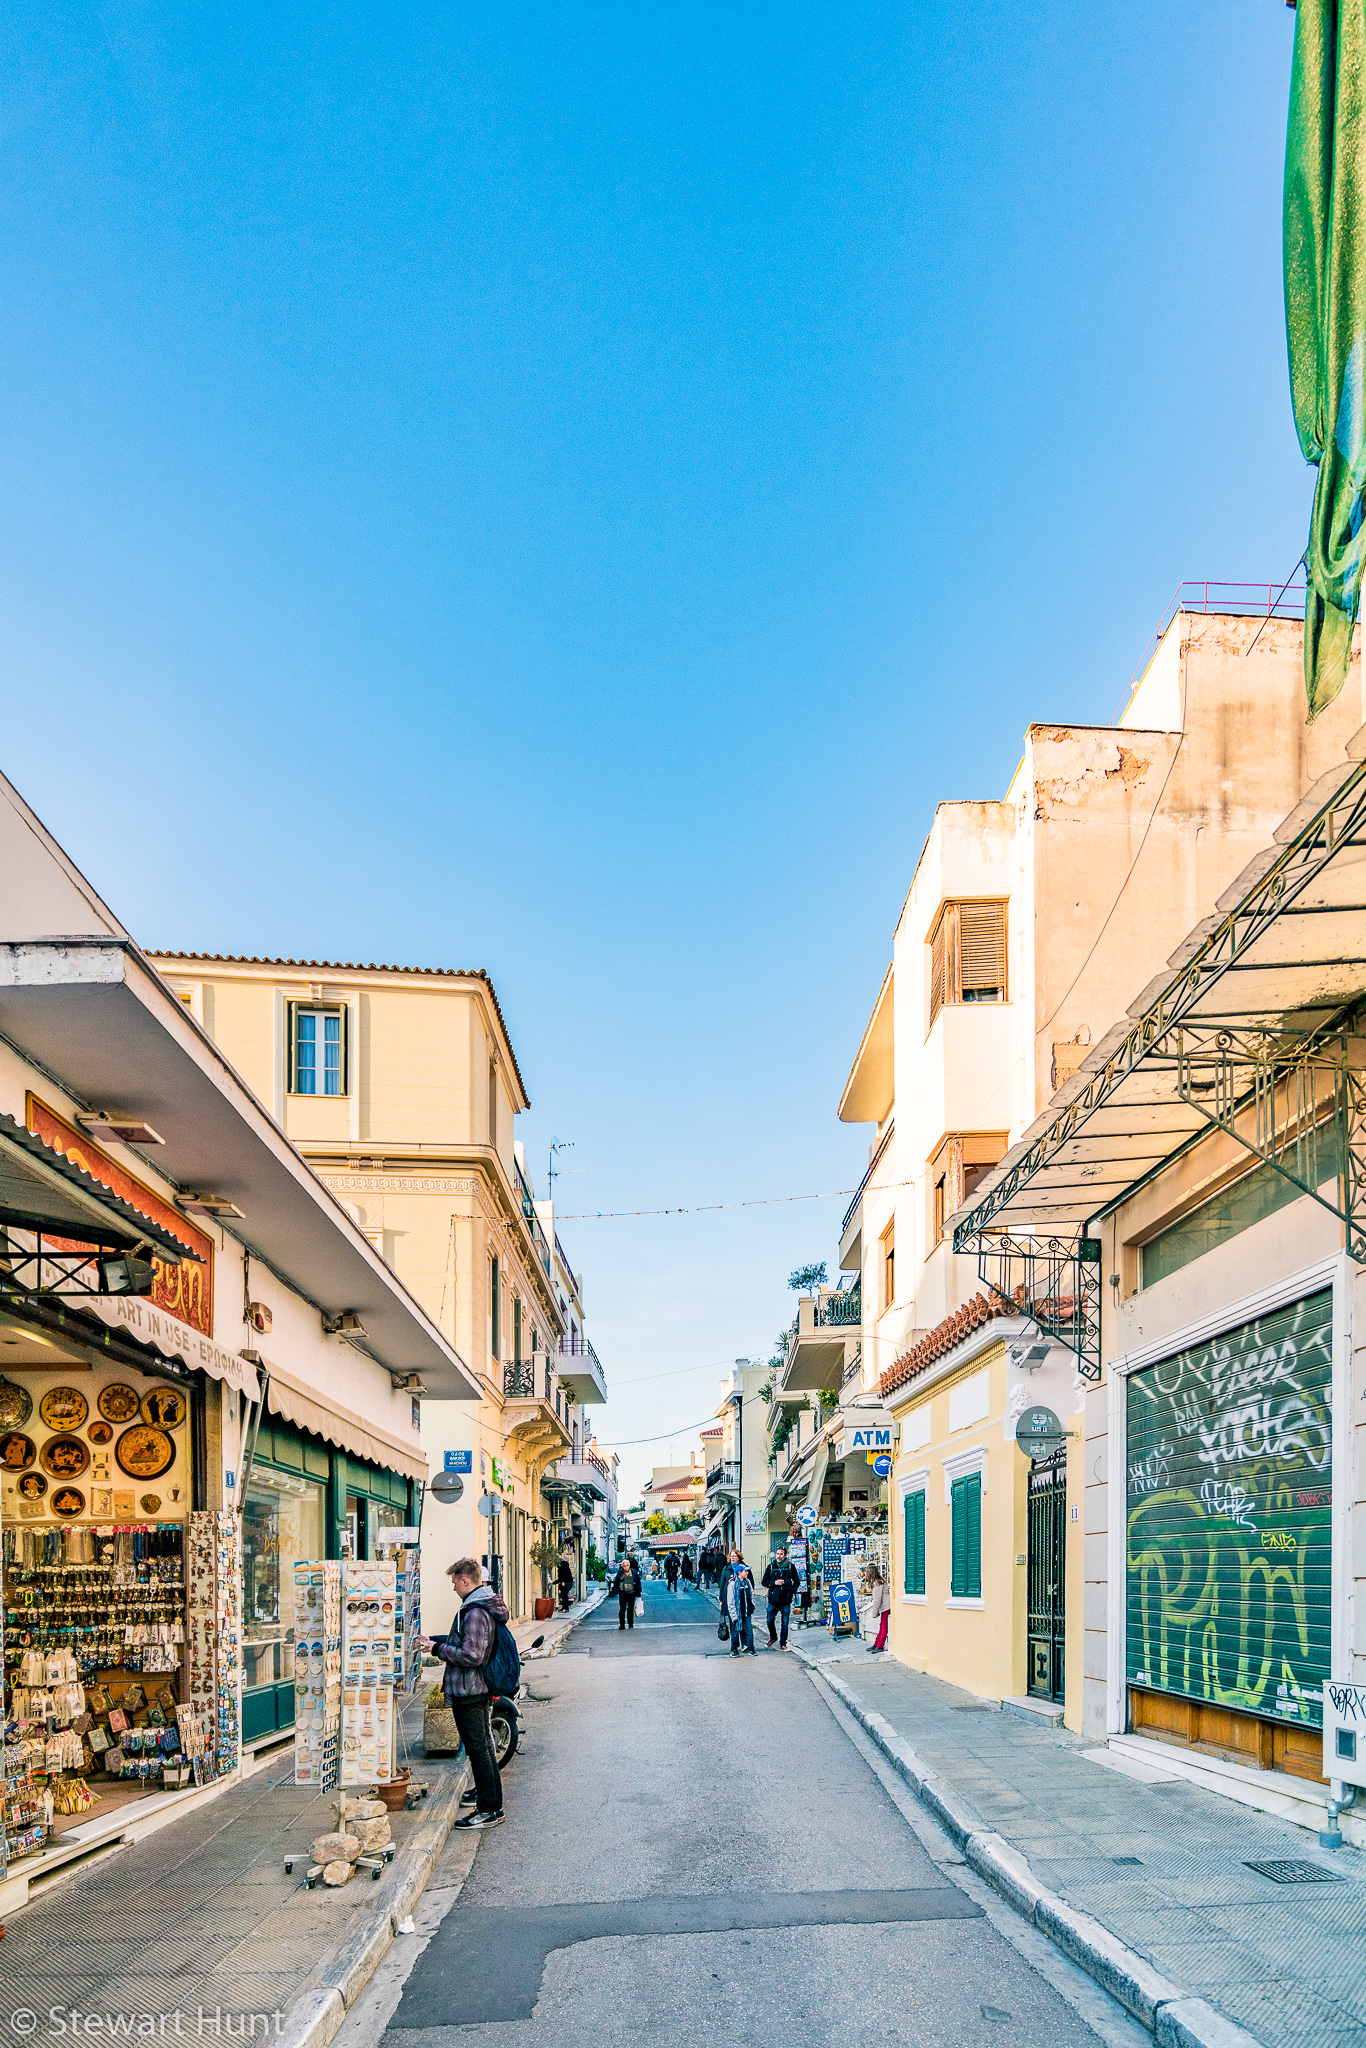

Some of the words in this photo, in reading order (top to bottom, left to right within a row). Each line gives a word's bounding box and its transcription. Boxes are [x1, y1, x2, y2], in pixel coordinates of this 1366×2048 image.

[117, 1296, 142, 1327] ART
[147, 1310, 161, 1337] IN
[165, 1320, 190, 1352] USE
[852, 1430, 890, 1446] ATM
[841, 1603, 849, 1622] ATM
